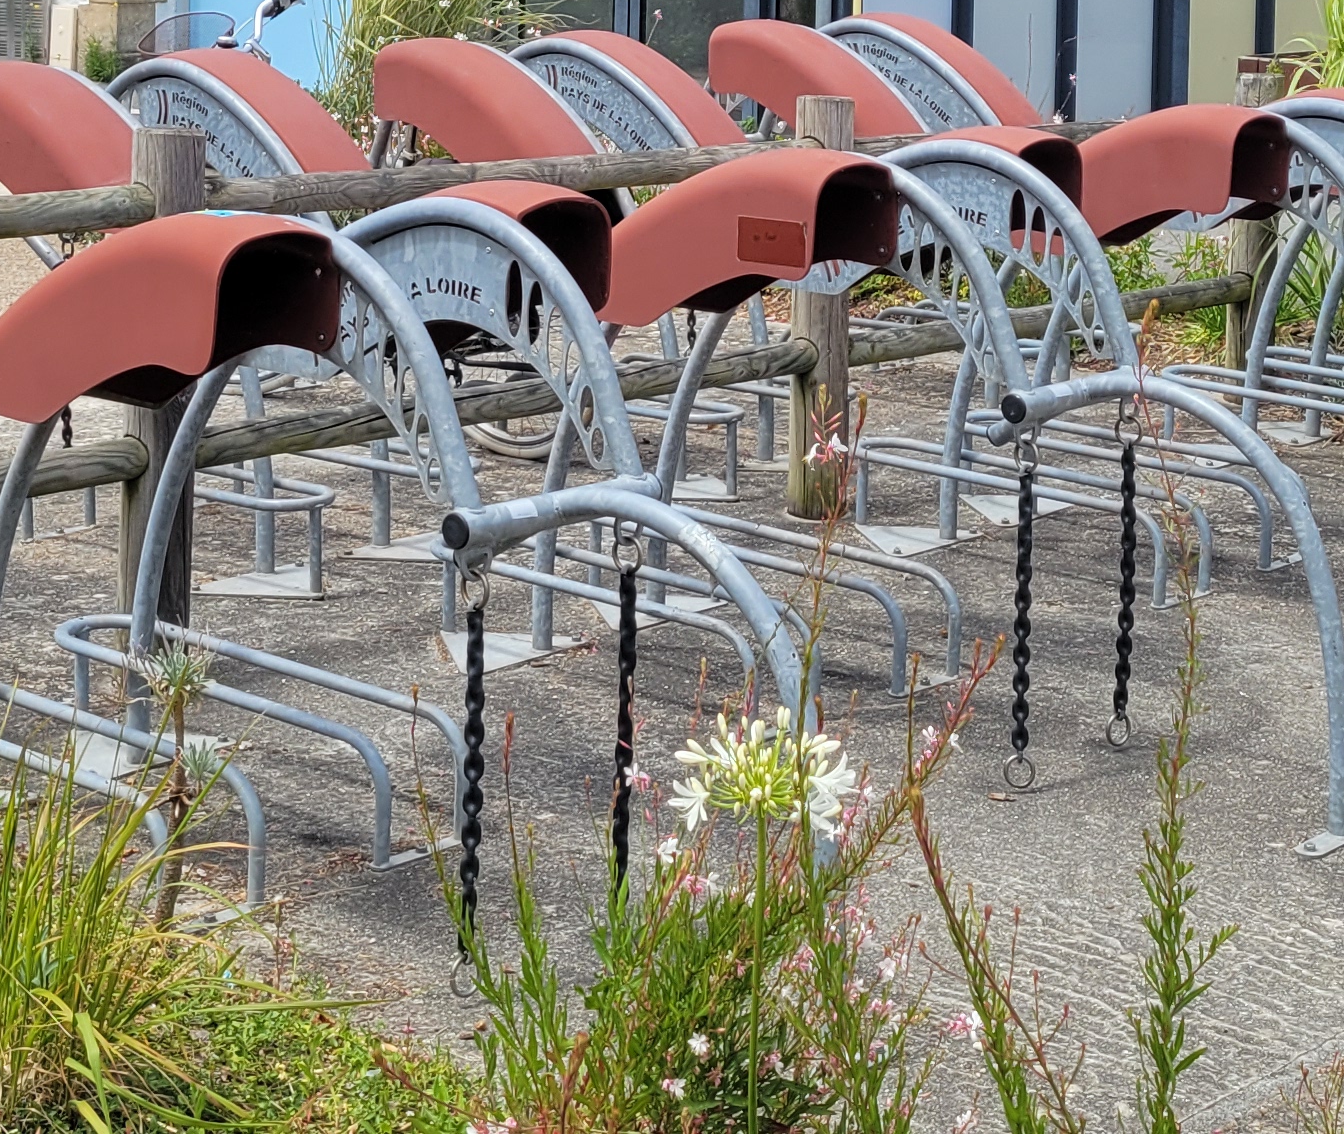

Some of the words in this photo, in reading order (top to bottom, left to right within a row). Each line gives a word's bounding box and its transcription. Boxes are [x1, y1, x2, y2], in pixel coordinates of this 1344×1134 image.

[863, 43, 898, 65] Région
[561, 65, 598, 88] Région
[172, 91, 208, 116] Région
[561, 86, 590, 105] PAYS
[592, 99, 608, 115] DE
[608, 110, 623, 127] LA
[909, 83, 923, 100] LA
[923, 95, 952, 126] LOIRE
[220, 143, 234, 163] LA
[425, 277, 483, 304] LOIRE
